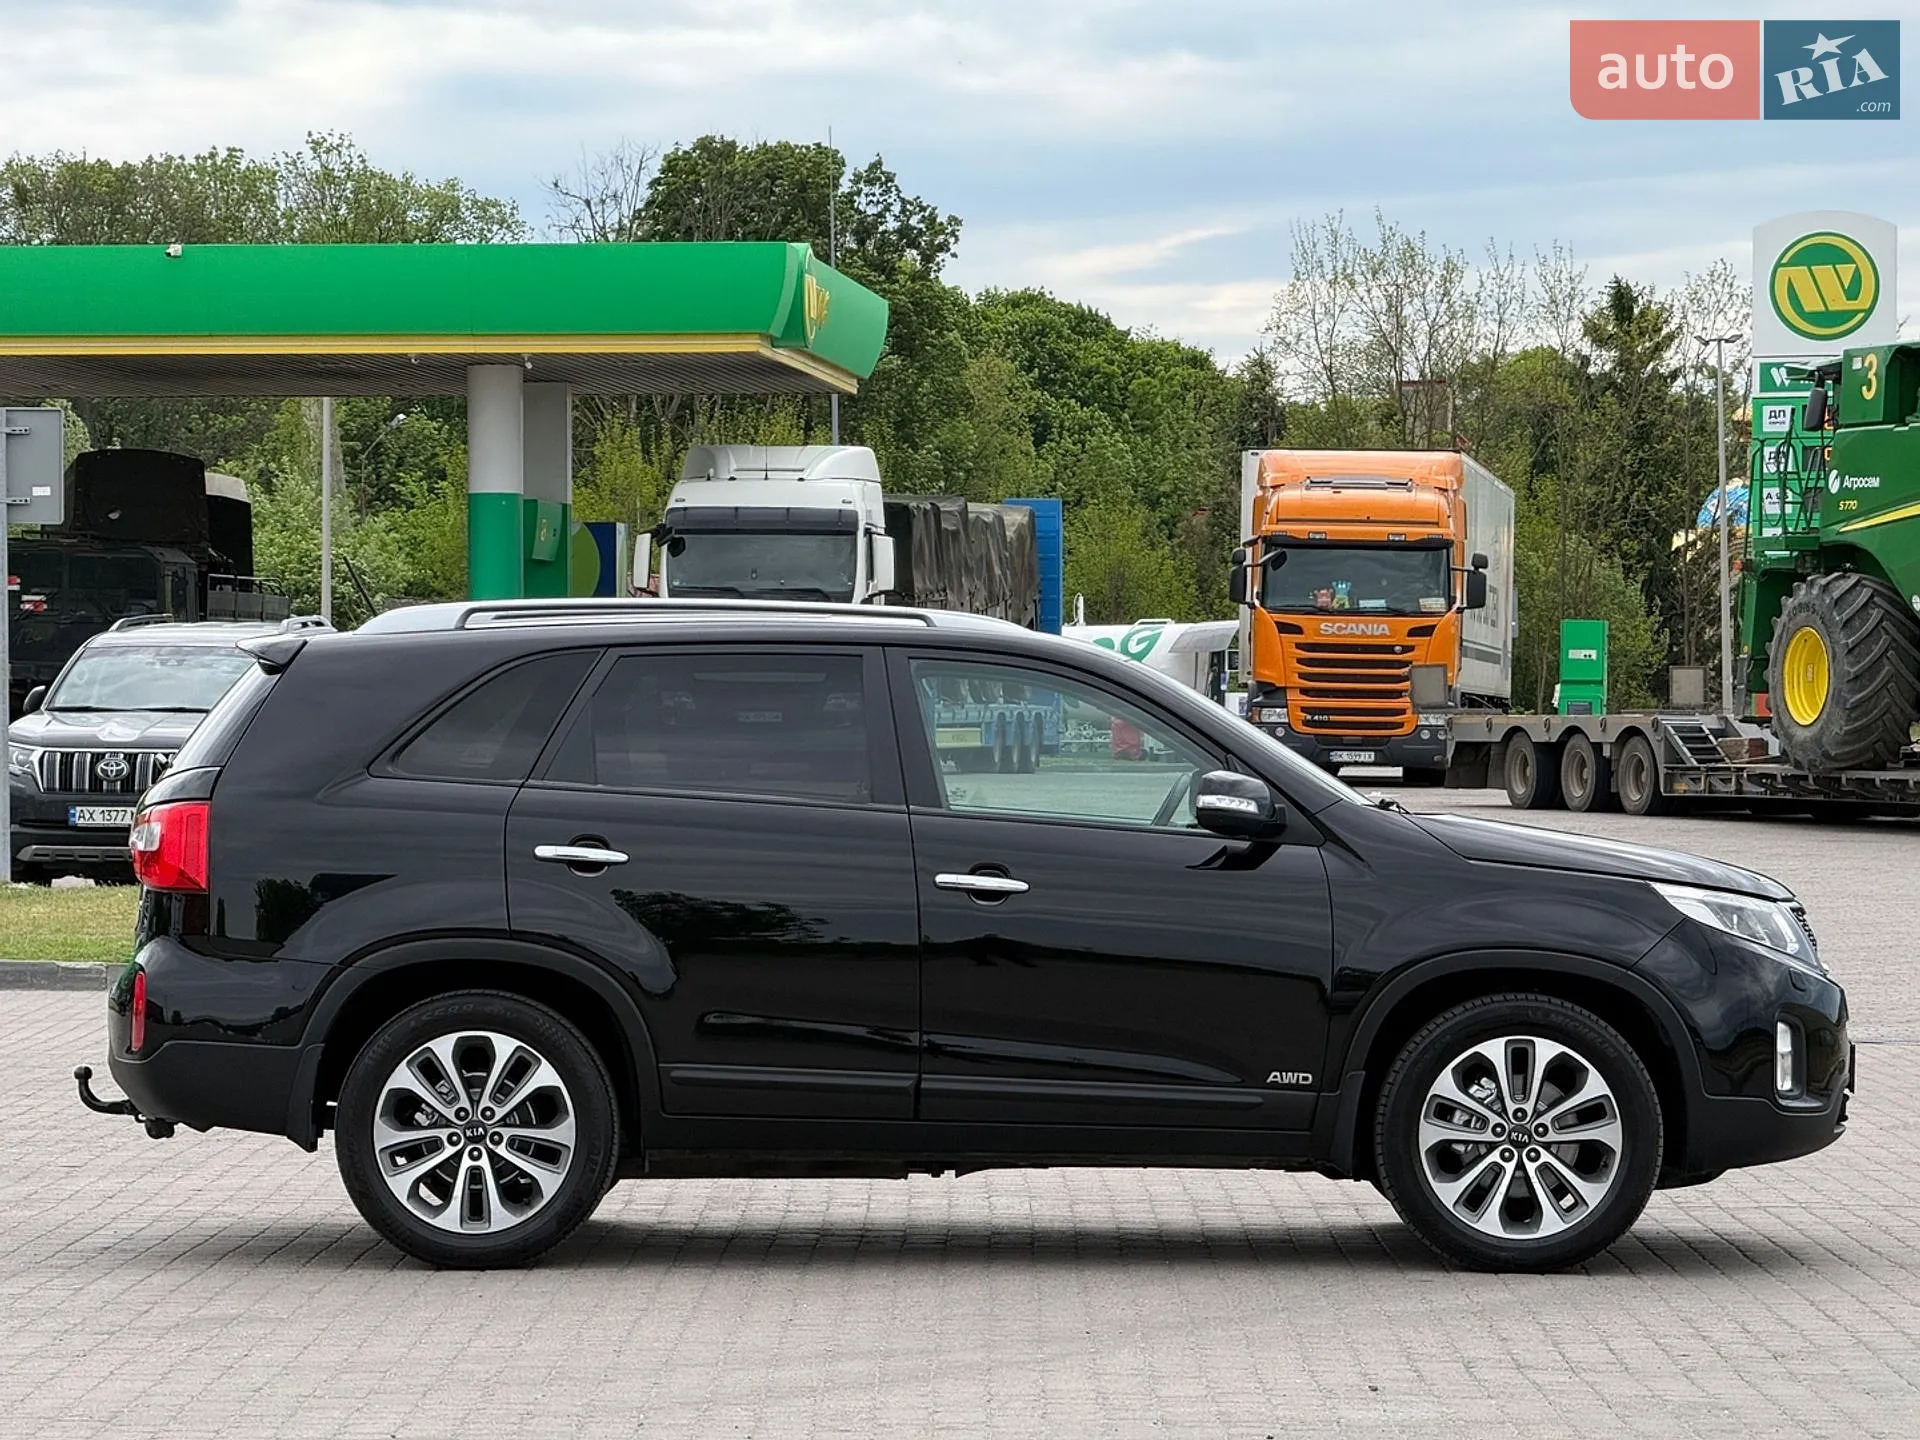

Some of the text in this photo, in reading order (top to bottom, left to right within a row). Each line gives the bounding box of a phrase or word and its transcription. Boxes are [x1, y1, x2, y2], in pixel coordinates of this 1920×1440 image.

[1861, 353, 1878, 400] 3
[1842, 475, 1880, 490] Агросем
[1319, 622, 1391, 636] SCANIA
[77, 809, 96, 822] AX
[100, 809, 128, 822] 1377
[1266, 1071, 1313, 1085] AWD
[465, 1128, 485, 1138] KIA
[1510, 1132, 1529, 1143] KIA
